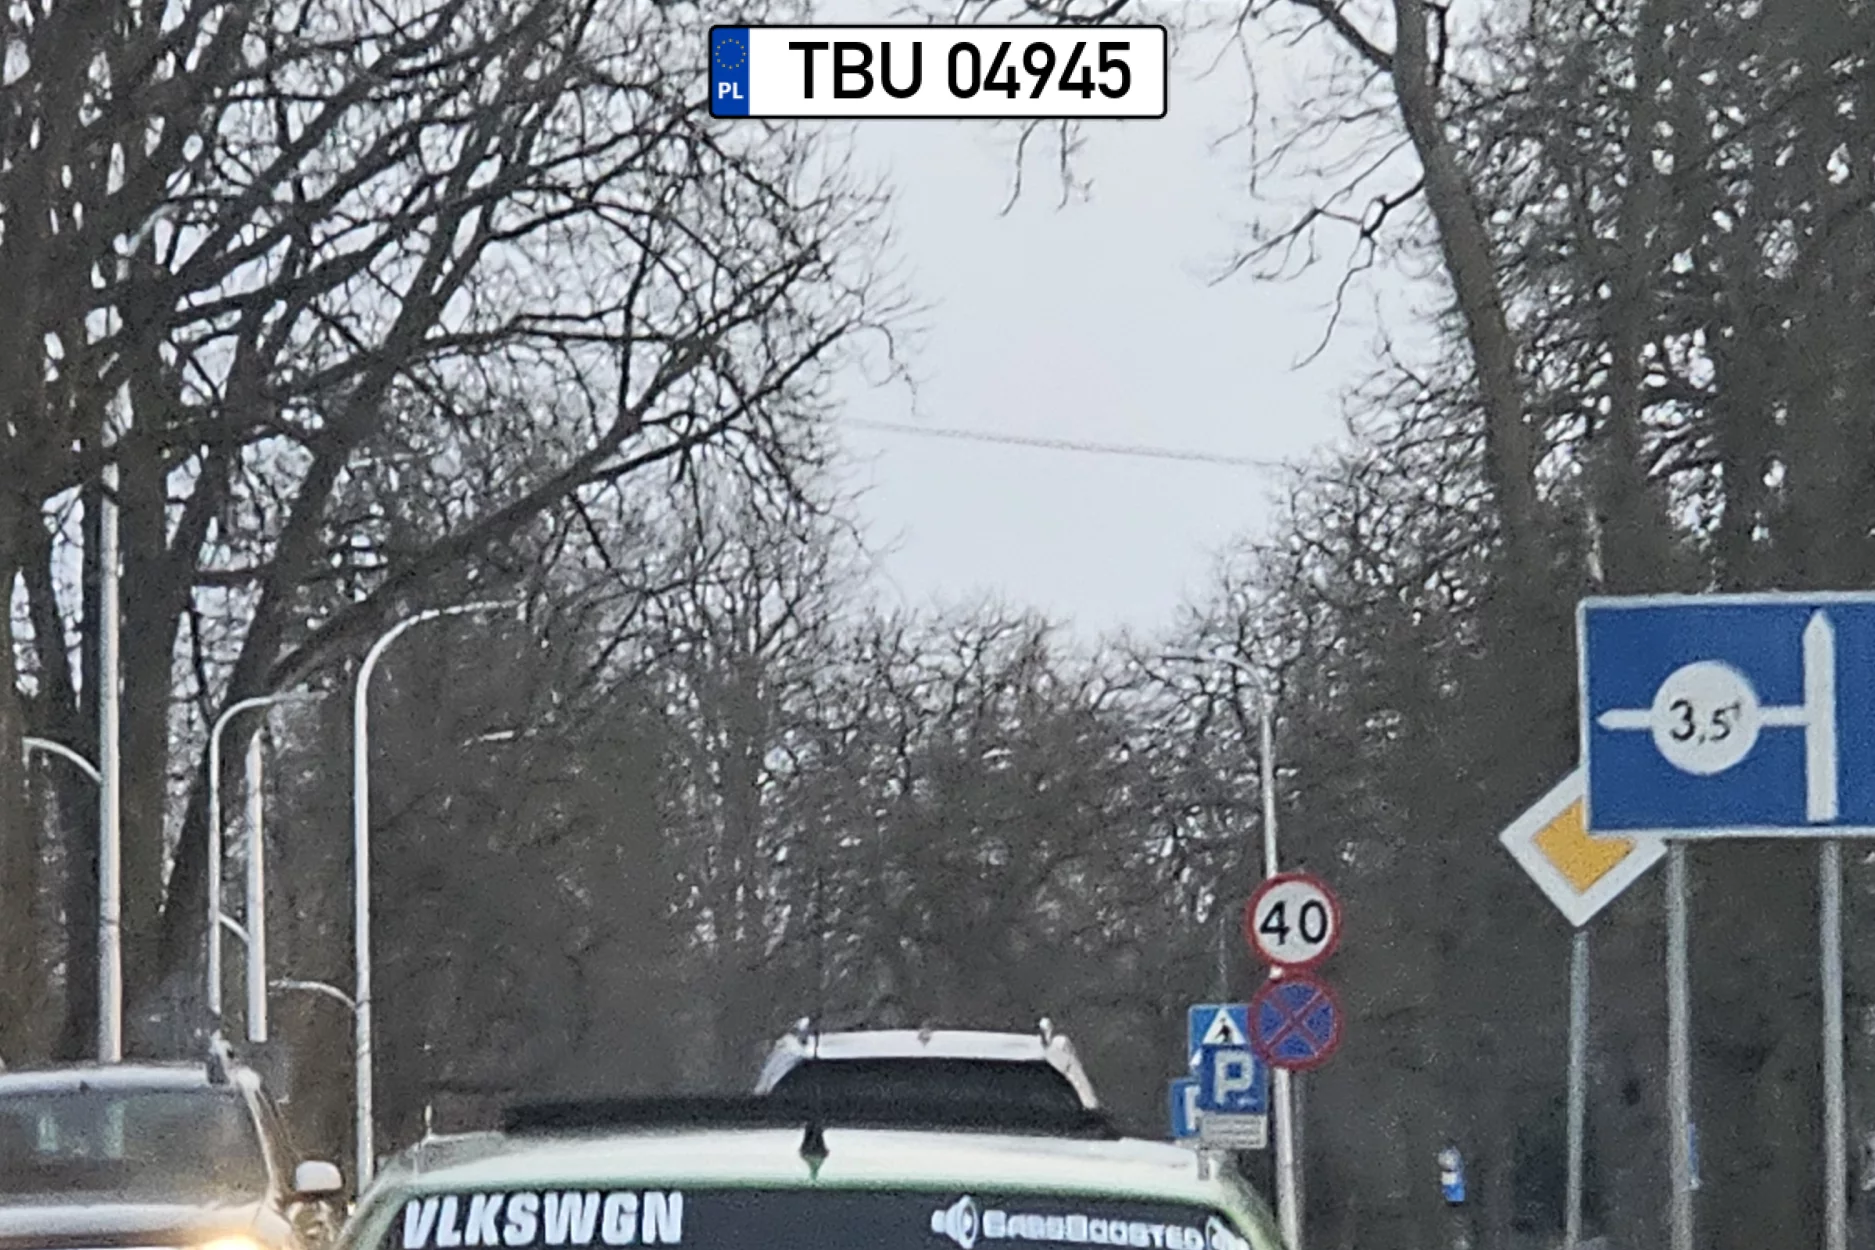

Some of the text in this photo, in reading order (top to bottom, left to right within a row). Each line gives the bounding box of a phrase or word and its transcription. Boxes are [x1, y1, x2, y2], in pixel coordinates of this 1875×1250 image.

[1260, 899, 1328, 945] 40
[1214, 1050, 1254, 1105] P
[403, 1191, 684, 1249] VLKSWGN
